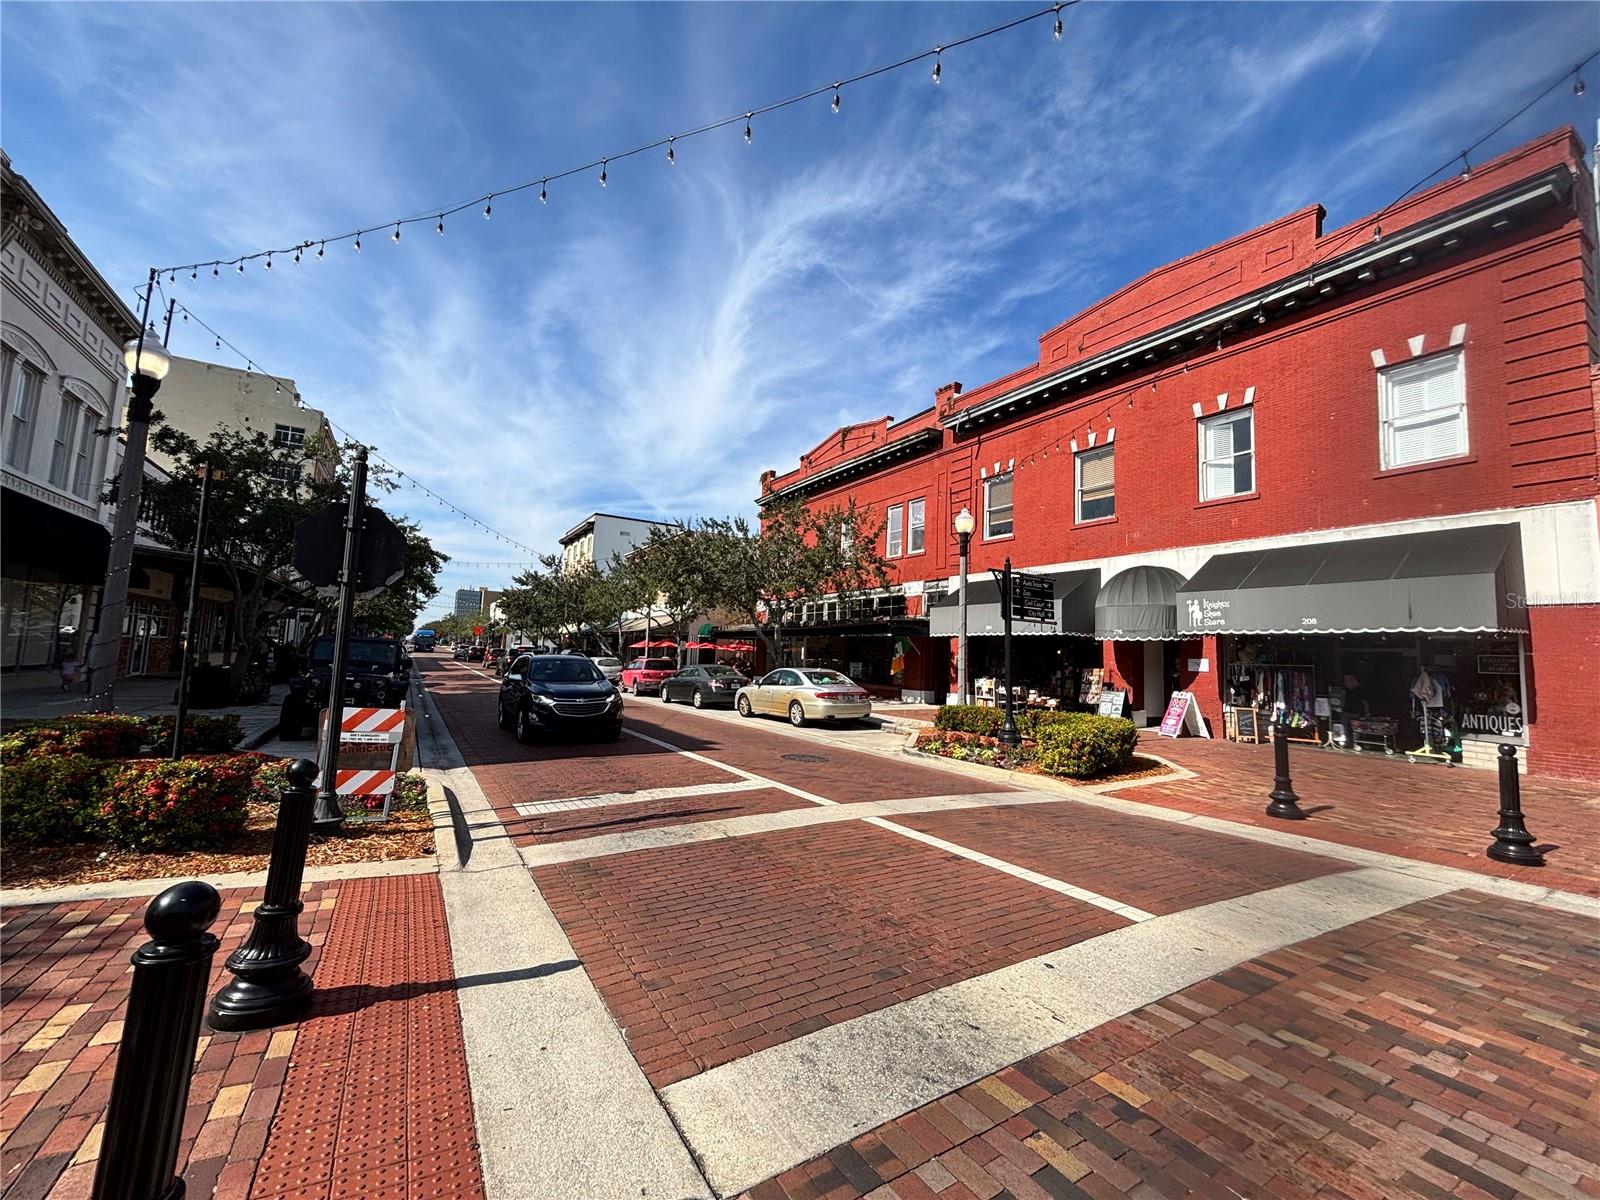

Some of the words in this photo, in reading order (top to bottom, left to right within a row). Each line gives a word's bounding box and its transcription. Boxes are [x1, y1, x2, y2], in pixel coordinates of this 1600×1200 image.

[1203, 609, 1221, 619] Shoe
[1203, 618, 1226, 626] Store
[1461, 713, 1523, 734] ANTIQUES
